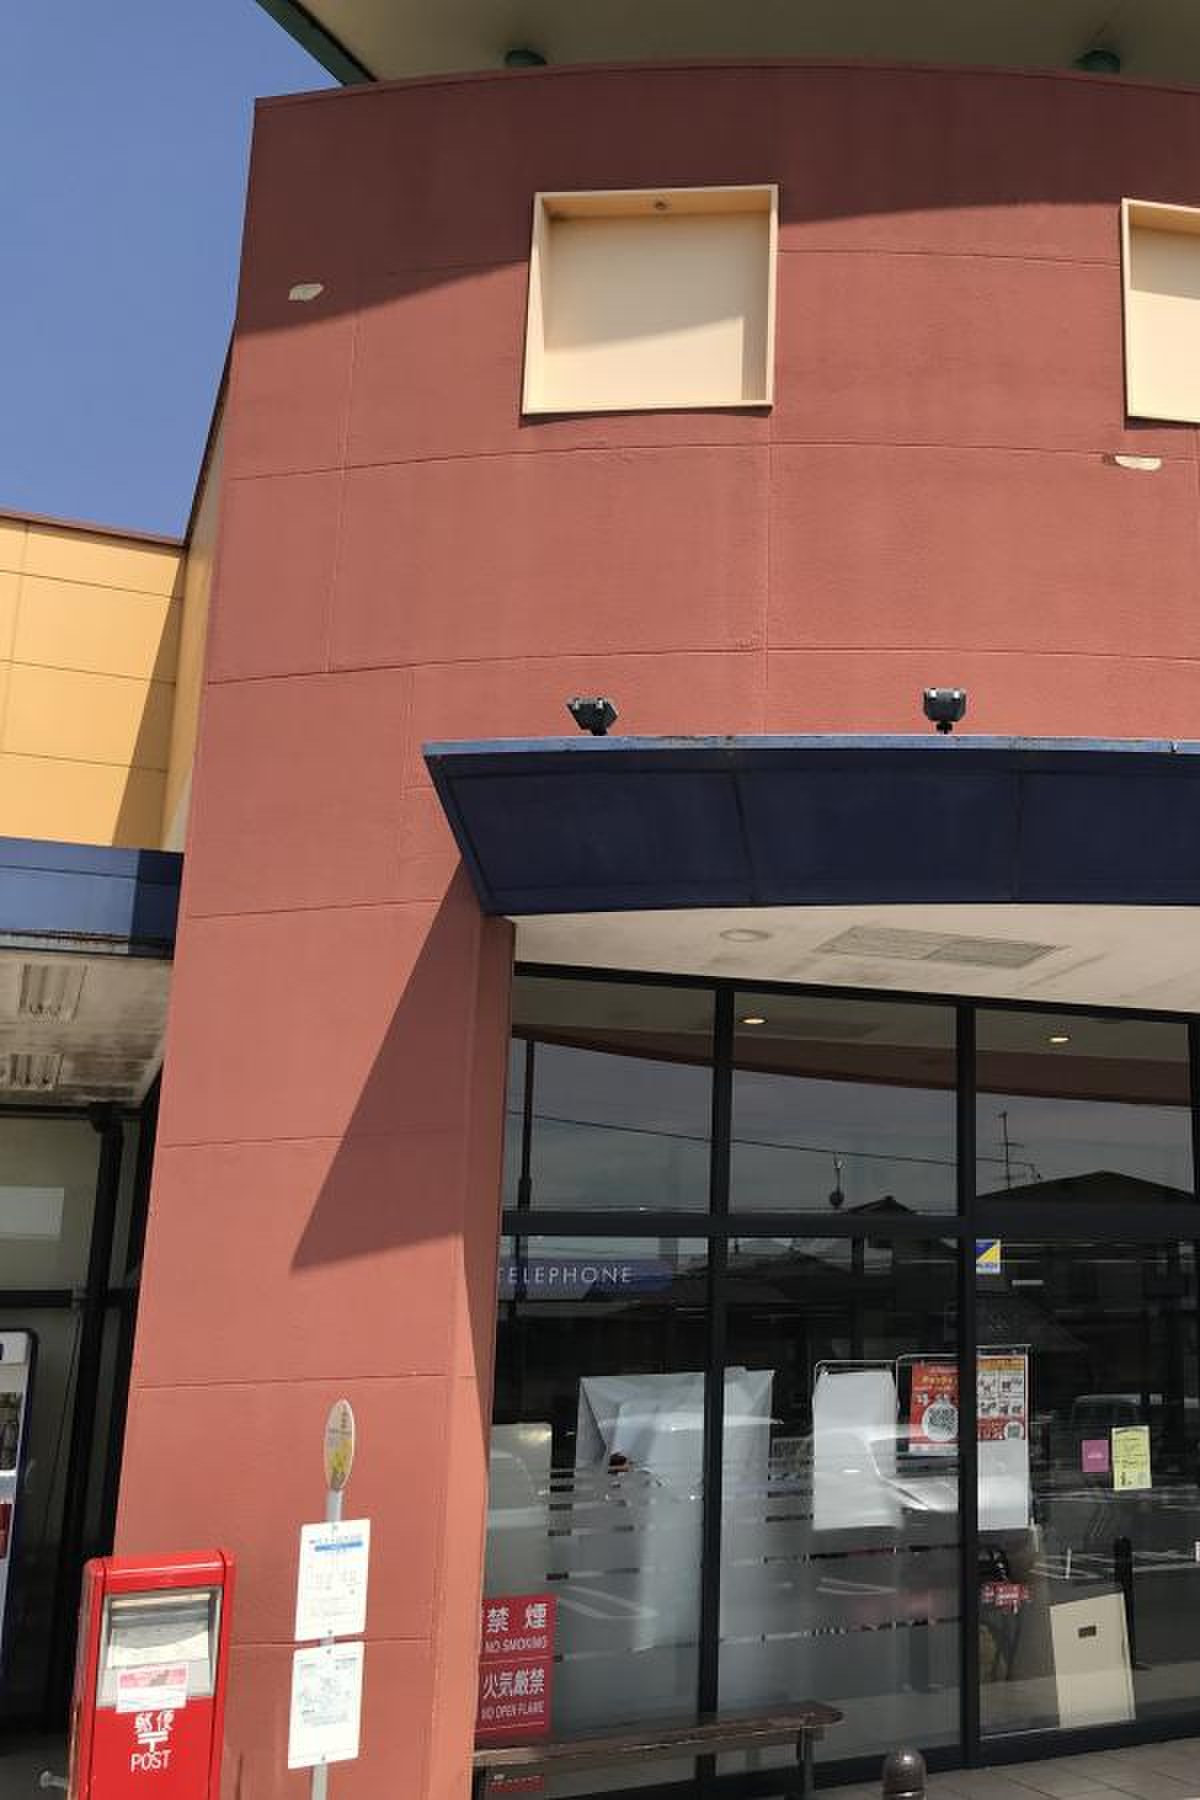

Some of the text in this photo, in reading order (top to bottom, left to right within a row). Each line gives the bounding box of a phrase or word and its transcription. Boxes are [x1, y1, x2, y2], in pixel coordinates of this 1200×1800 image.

[482, 1667, 544, 1698] 火気厳禁
[134, 1709, 175, 1734] 郵便
[130, 1749, 172, 1773] POST
